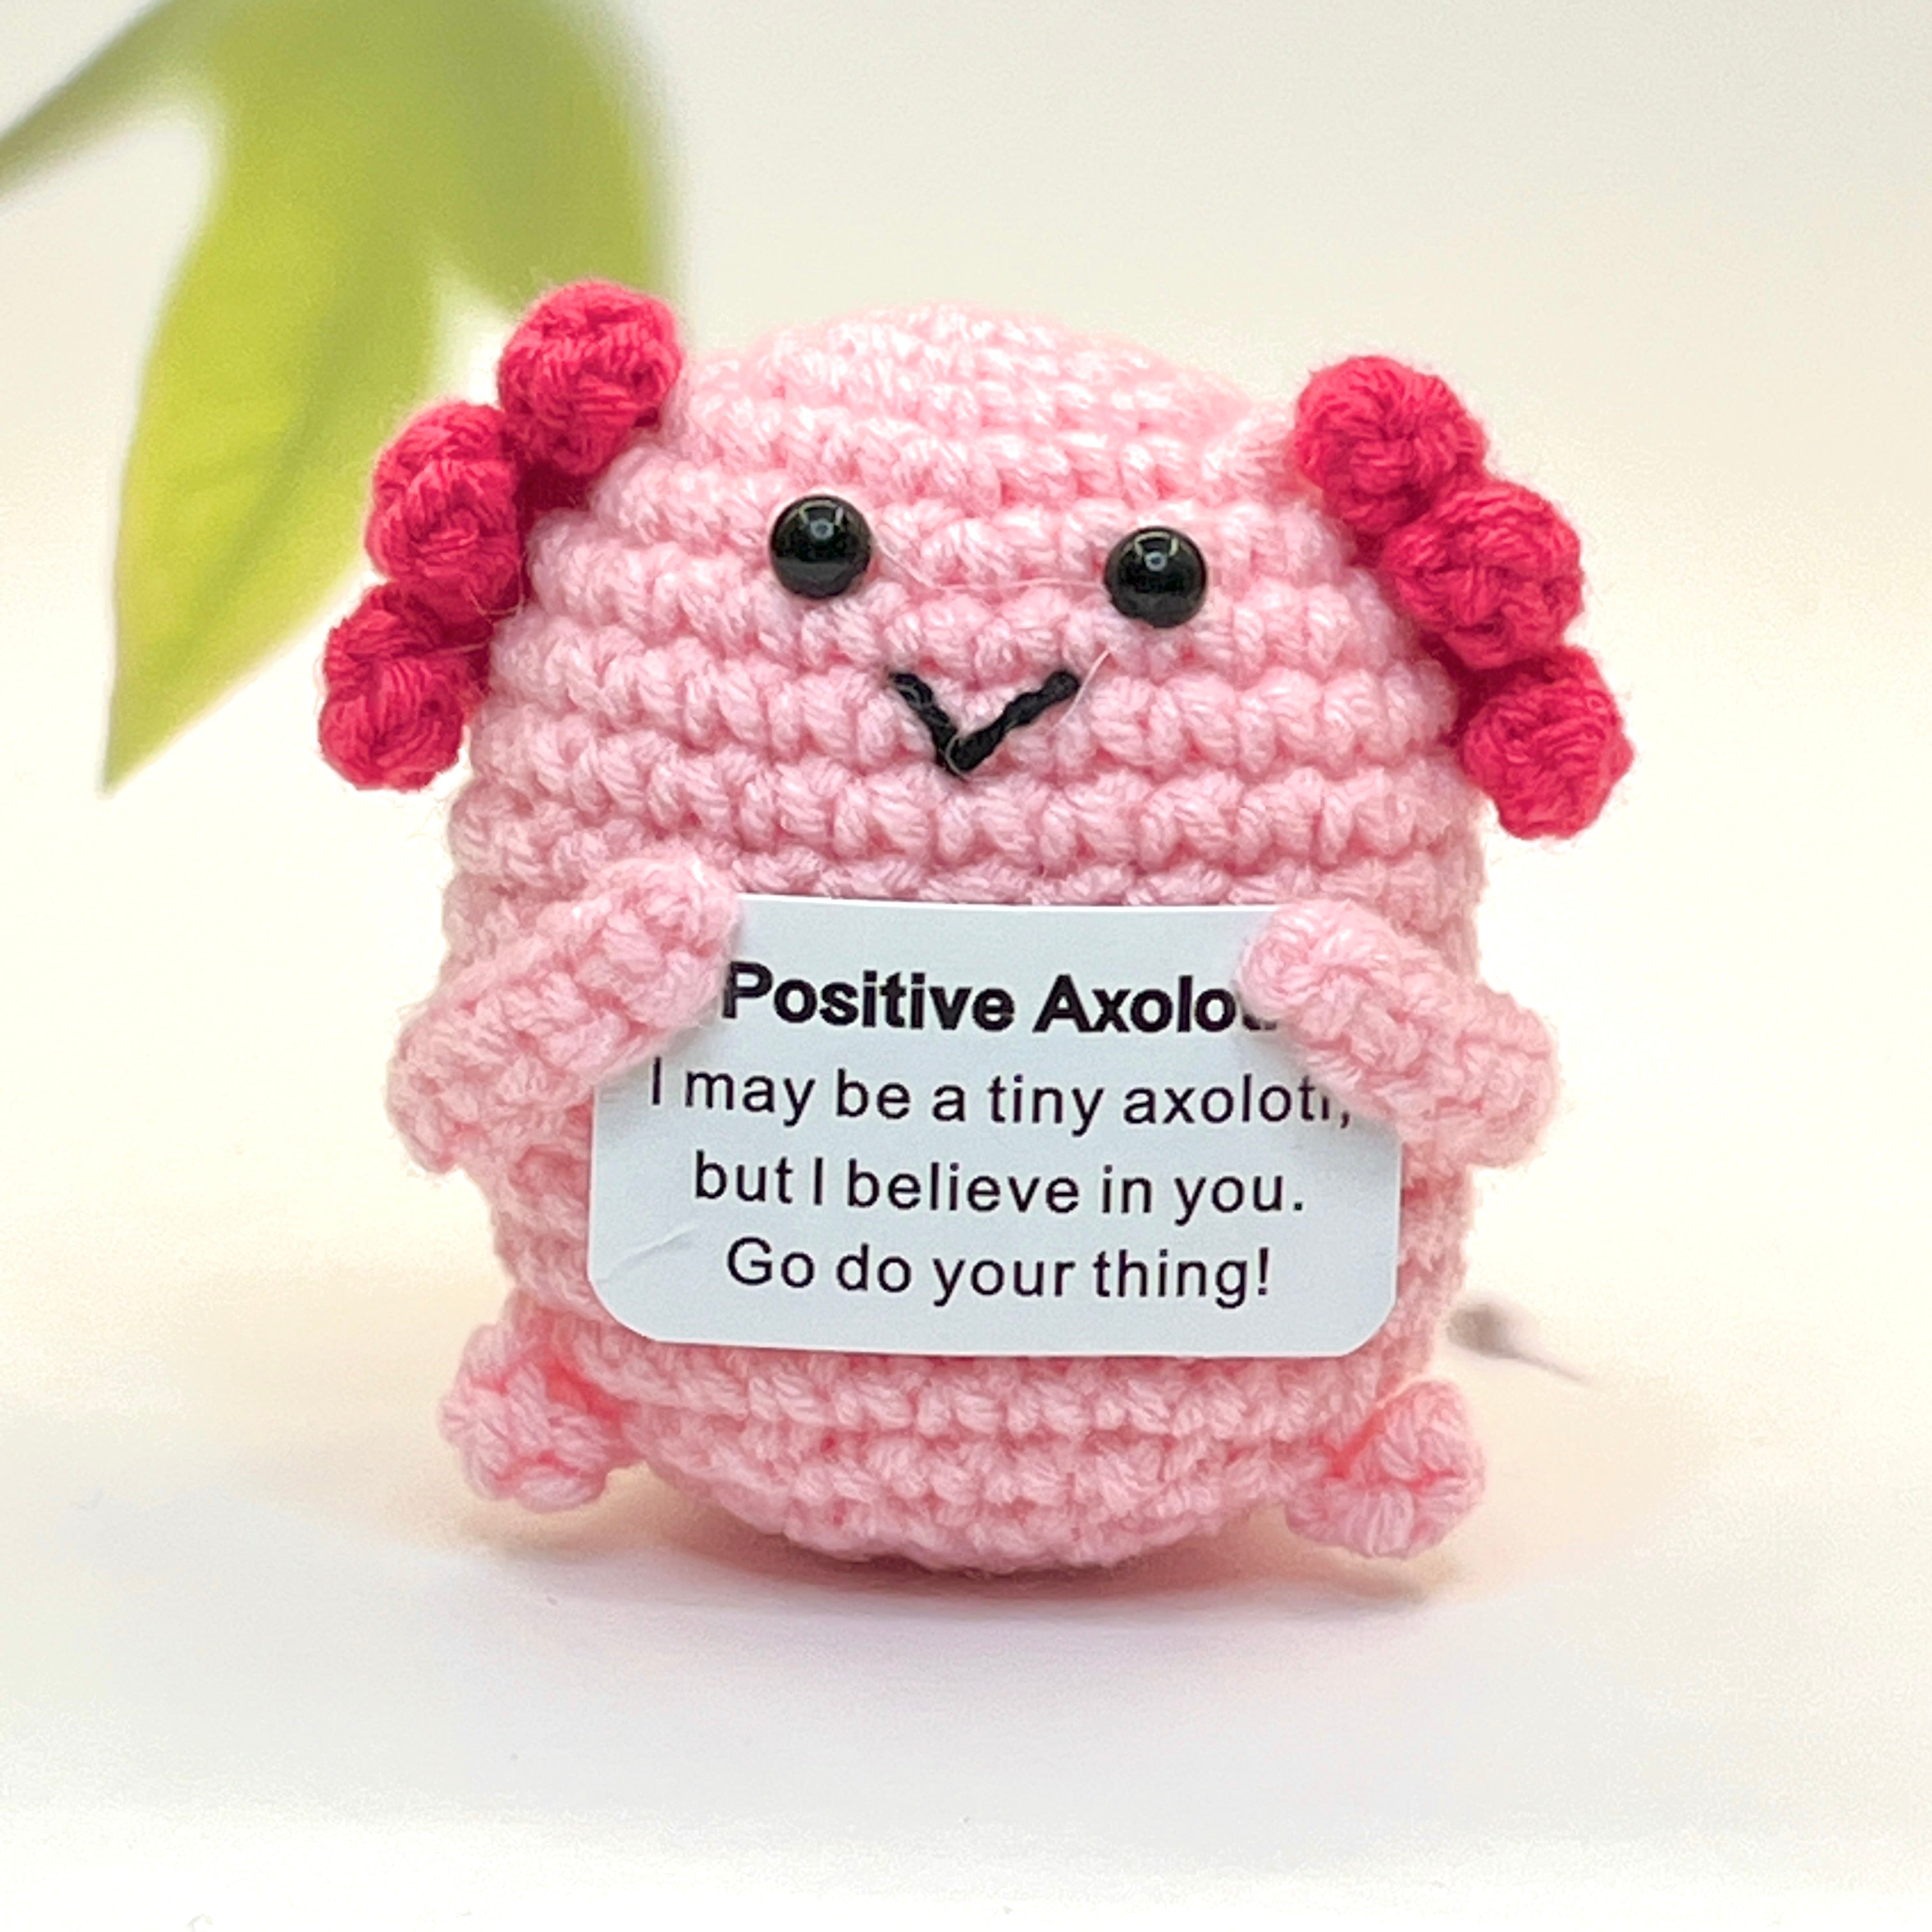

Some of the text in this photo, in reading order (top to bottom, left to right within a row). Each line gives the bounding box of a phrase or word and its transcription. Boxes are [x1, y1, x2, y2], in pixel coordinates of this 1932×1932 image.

[722, 960, 1278, 1033] Positive Axolo
[652, 1055, 662, 1106] I
[685, 1071, 816, 1127] may
[836, 1068, 910, 1120] be
[933, 1084, 965, 1123] a
[987, 1075, 1105, 1137] tiny
[696, 1149, 1303, 1227] but I believe in you.
[728, 1236, 1269, 1310] Go do your thing!
